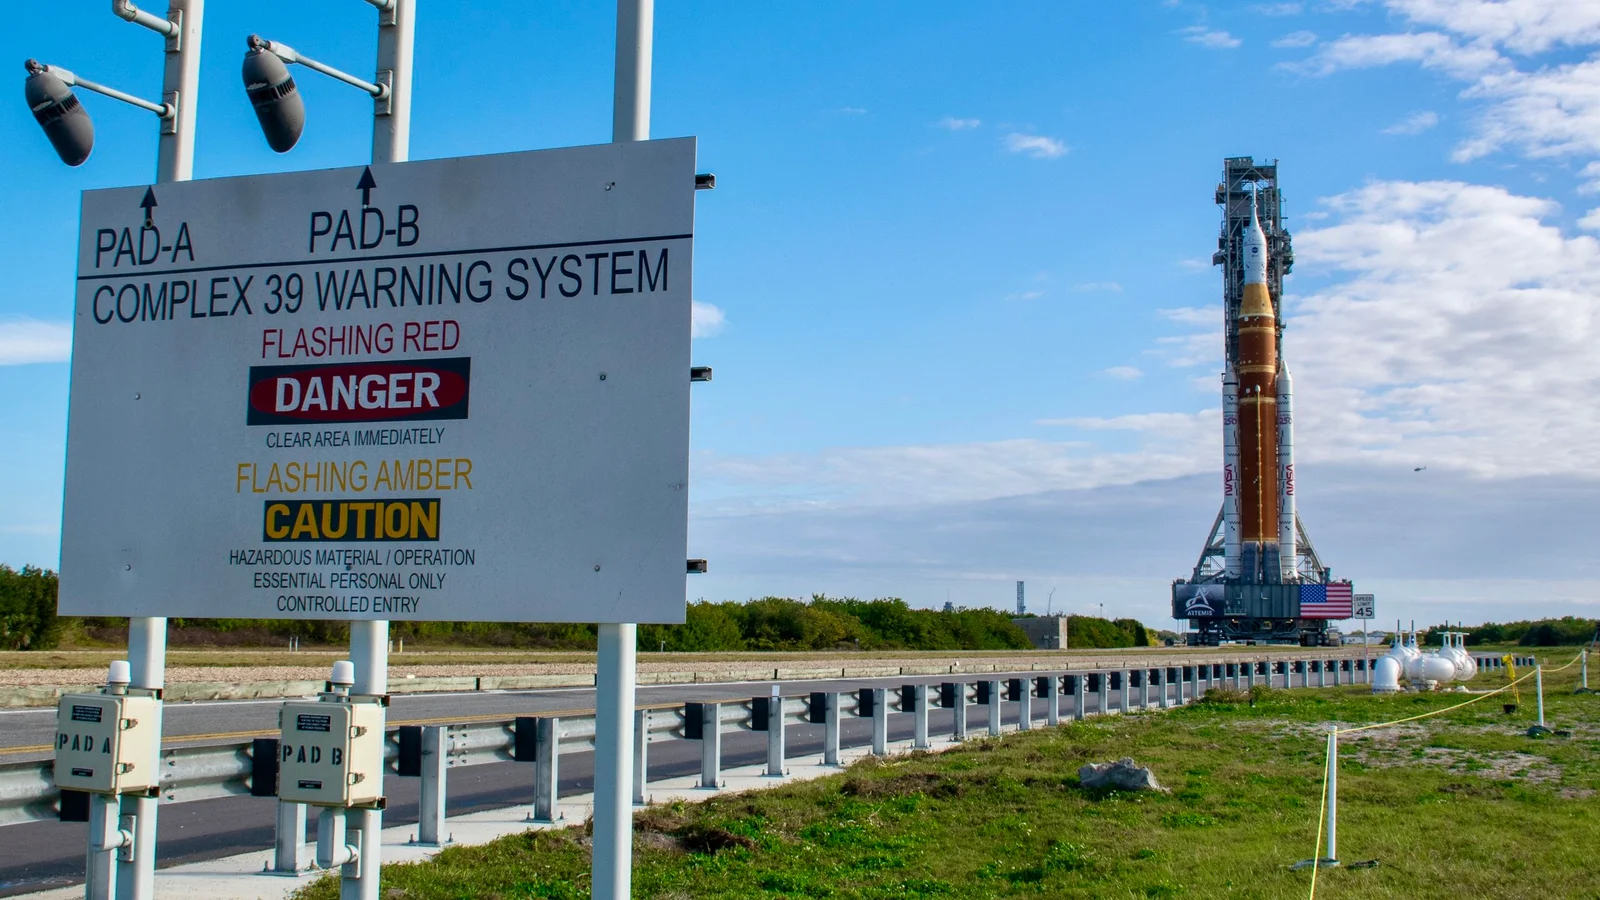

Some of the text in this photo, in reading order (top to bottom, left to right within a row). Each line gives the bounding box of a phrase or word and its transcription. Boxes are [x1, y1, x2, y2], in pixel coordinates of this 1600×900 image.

[309, 204, 420, 253] PAD-B
[95, 222, 195, 268] PAD-A
[93, 248, 668, 324] COMPLEX 39 WARNING SYSTEM
[262, 320, 460, 358] FLASHING RED
[275, 371, 440, 412] DANGER
[266, 428, 445, 448] CLEAR AREA IMMEDIATELY
[236, 458, 473, 493] FLASHING AMBER
[265, 501, 438, 539] CAUTION
[229, 549, 312, 565] HAZARDOUS
[316, 549, 383, 566] MATERIAL
[394, 549, 475, 566] OPERATION
[253, 572, 446, 589] ESSENTIAL PERSONAL ONLY
[277, 595, 420, 612] CONTROLLED ENTRY
[1356, 607, 1373, 616] 45
[59, 733, 111, 754] PAD A
[282, 744, 343, 766] PAD B
